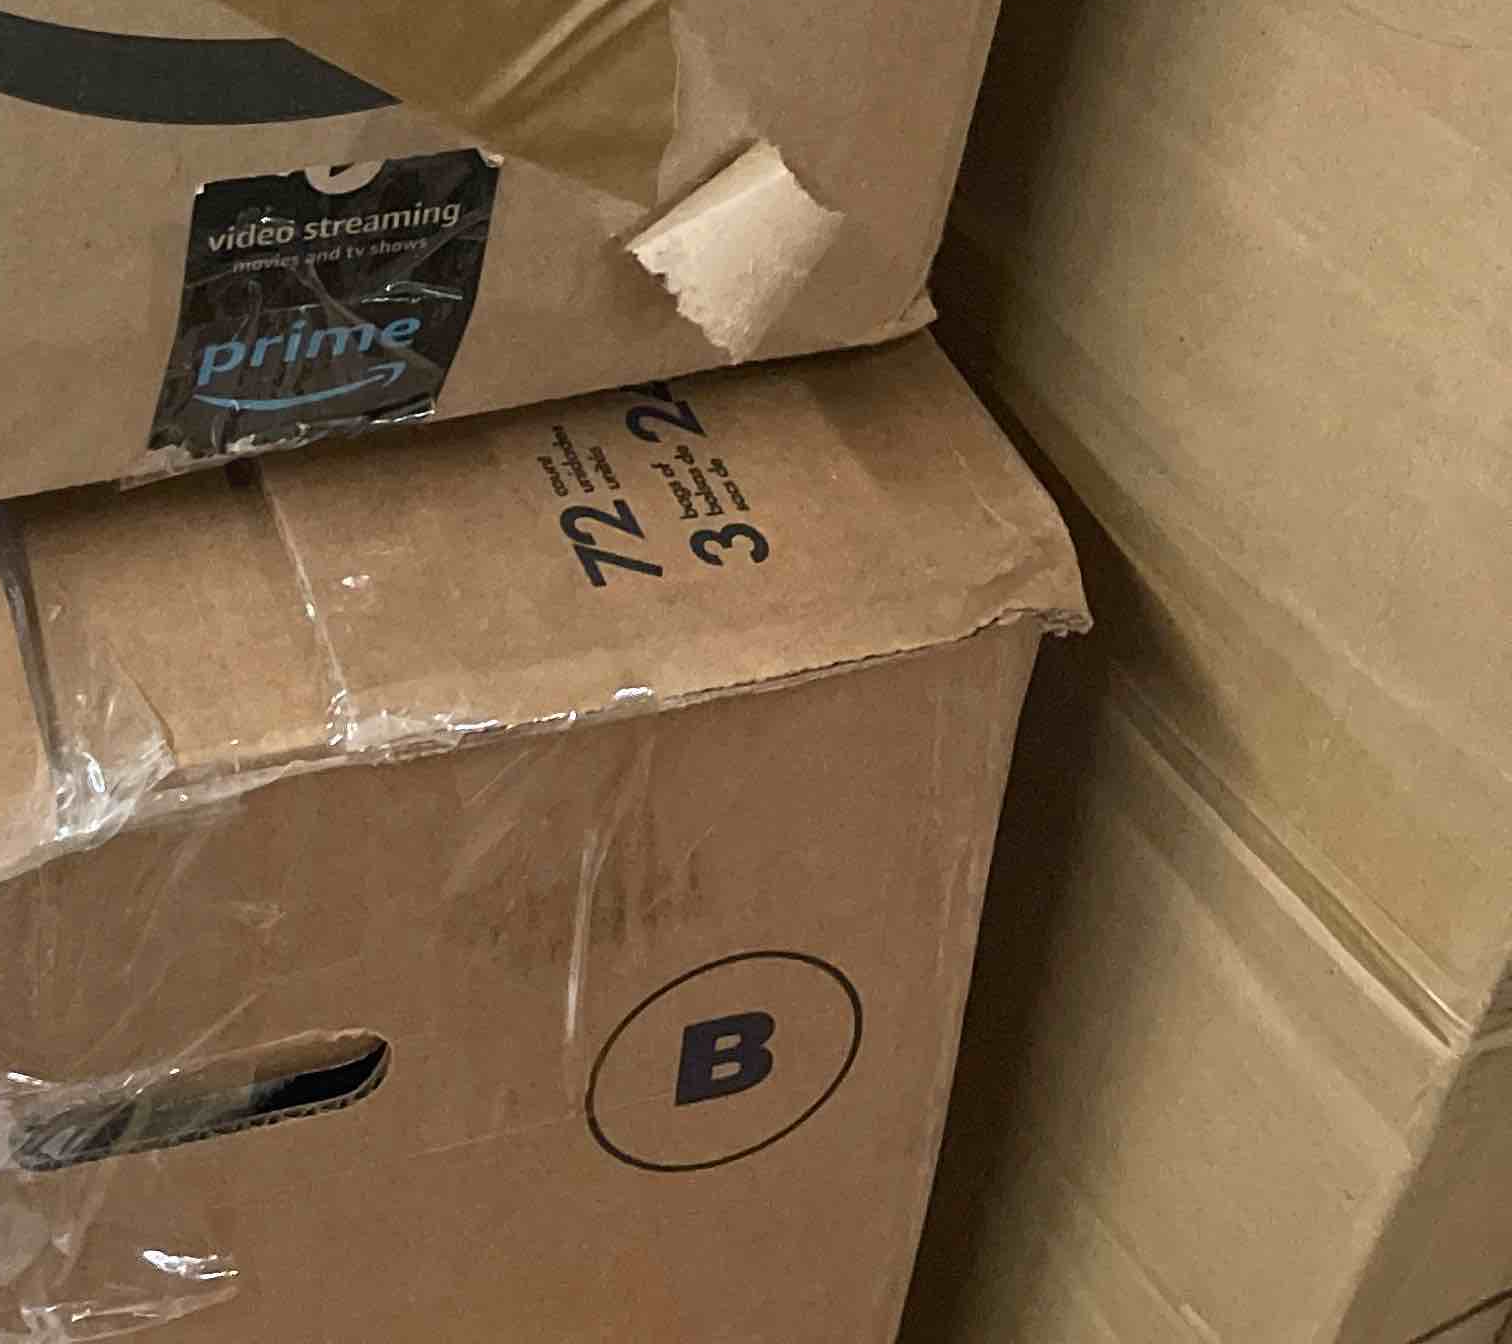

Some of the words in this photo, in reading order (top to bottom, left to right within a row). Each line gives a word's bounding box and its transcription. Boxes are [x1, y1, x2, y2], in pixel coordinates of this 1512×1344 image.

[208, 221, 296, 253] video
[303, 201, 461, 240] streaming
[305, 246, 341, 266] and
[346, 243, 365, 261] tv
[370, 236, 430, 255] shows
[197, 317, 422, 386] prime
[538, 455, 569, 496] count
[551, 425, 595, 494] unidades
[650, 462, 675, 478] of
[674, 444, 695, 465] de
[707, 458, 728, 479] de
[667, 477, 699, 520] bags
[689, 464, 724, 516] bolsas
[559, 499, 663, 588] 72
[689, 522, 770, 566] 3
[674, 1009, 777, 1109] B
